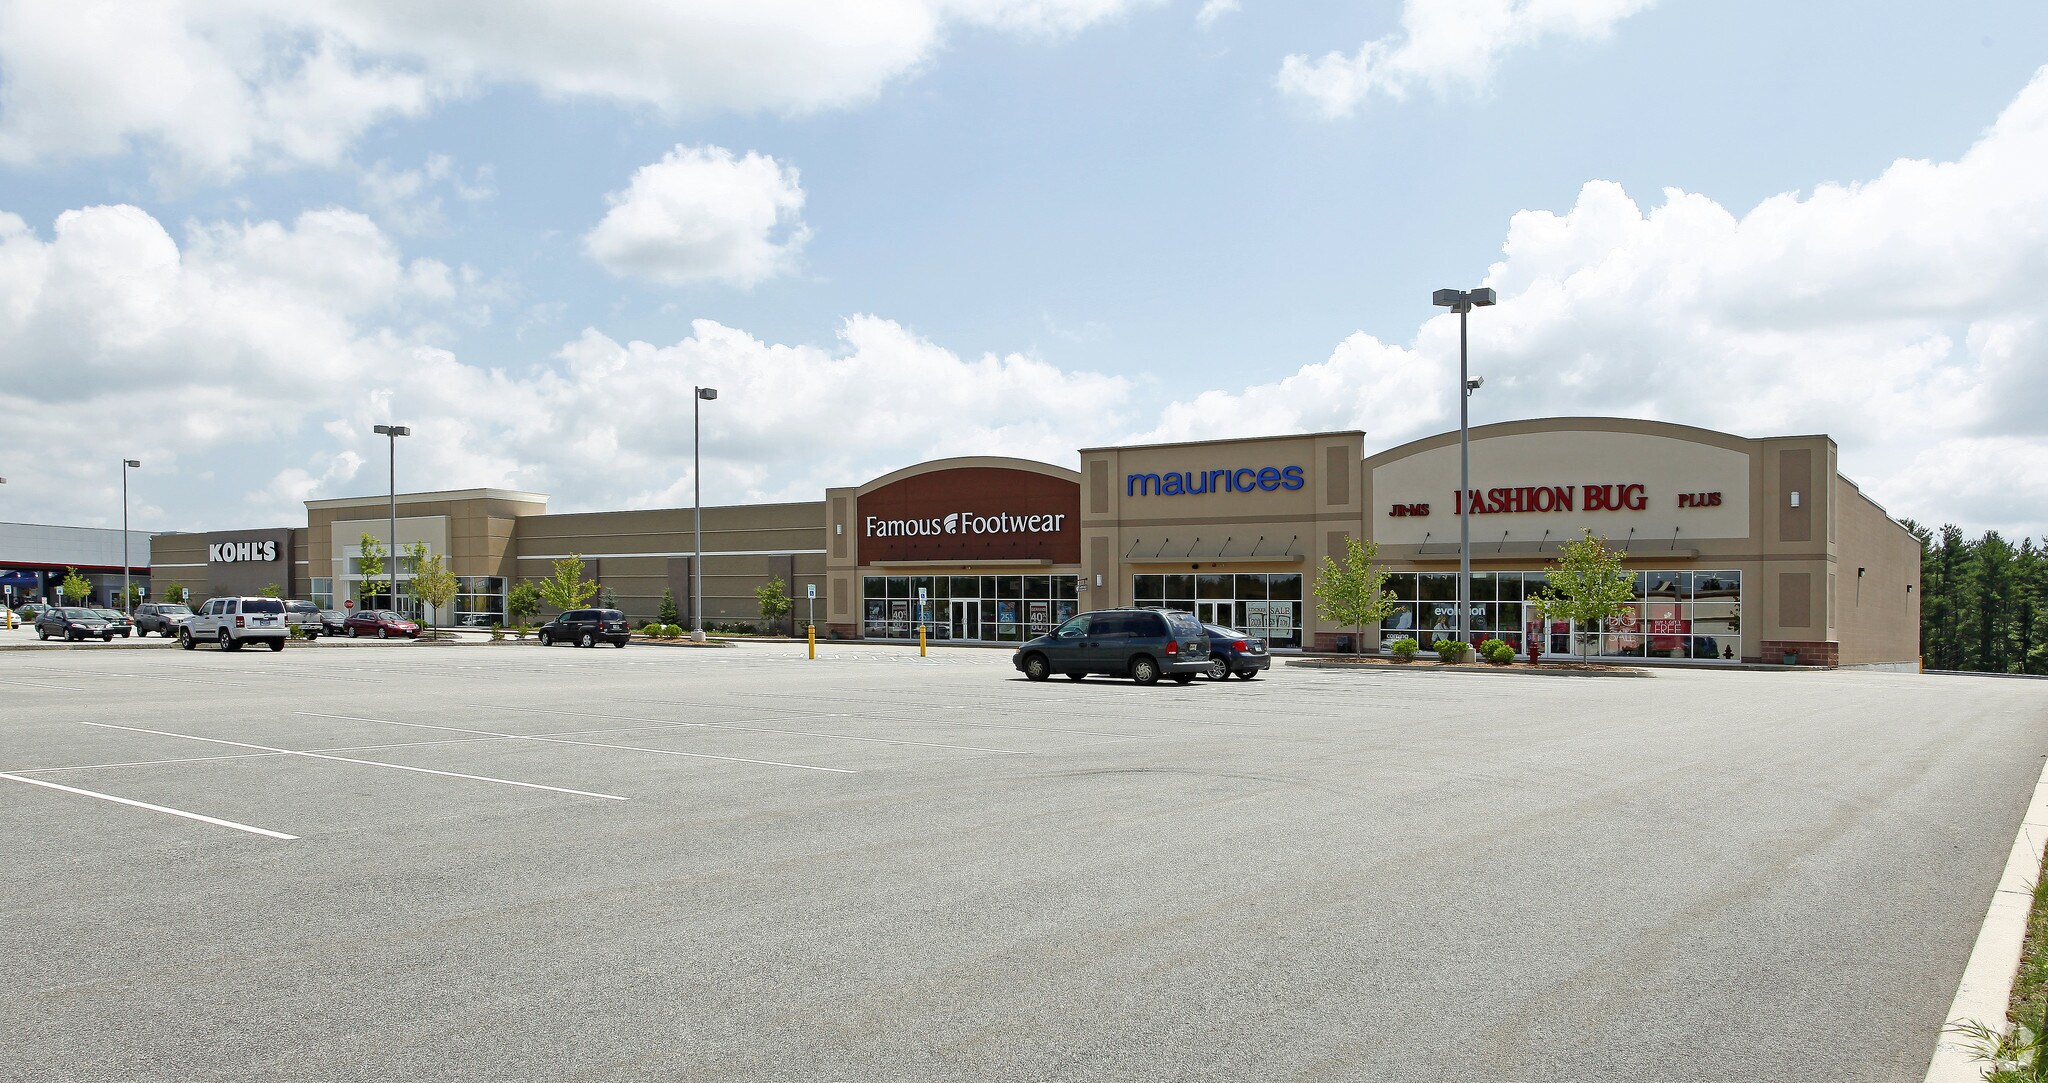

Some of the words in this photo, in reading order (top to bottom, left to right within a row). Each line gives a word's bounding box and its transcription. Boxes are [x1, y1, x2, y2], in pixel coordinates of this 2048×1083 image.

[1127, 465, 1305, 497] maurices
[1582, 484, 1648, 512] BUG
[1678, 492, 1722, 509] PLUS
[866, 516, 942, 537] Famous
[961, 511, 1065, 534] Footwear
[209, 540, 276, 563] KOHL'S
[1270, 607, 1290, 615] SALE
